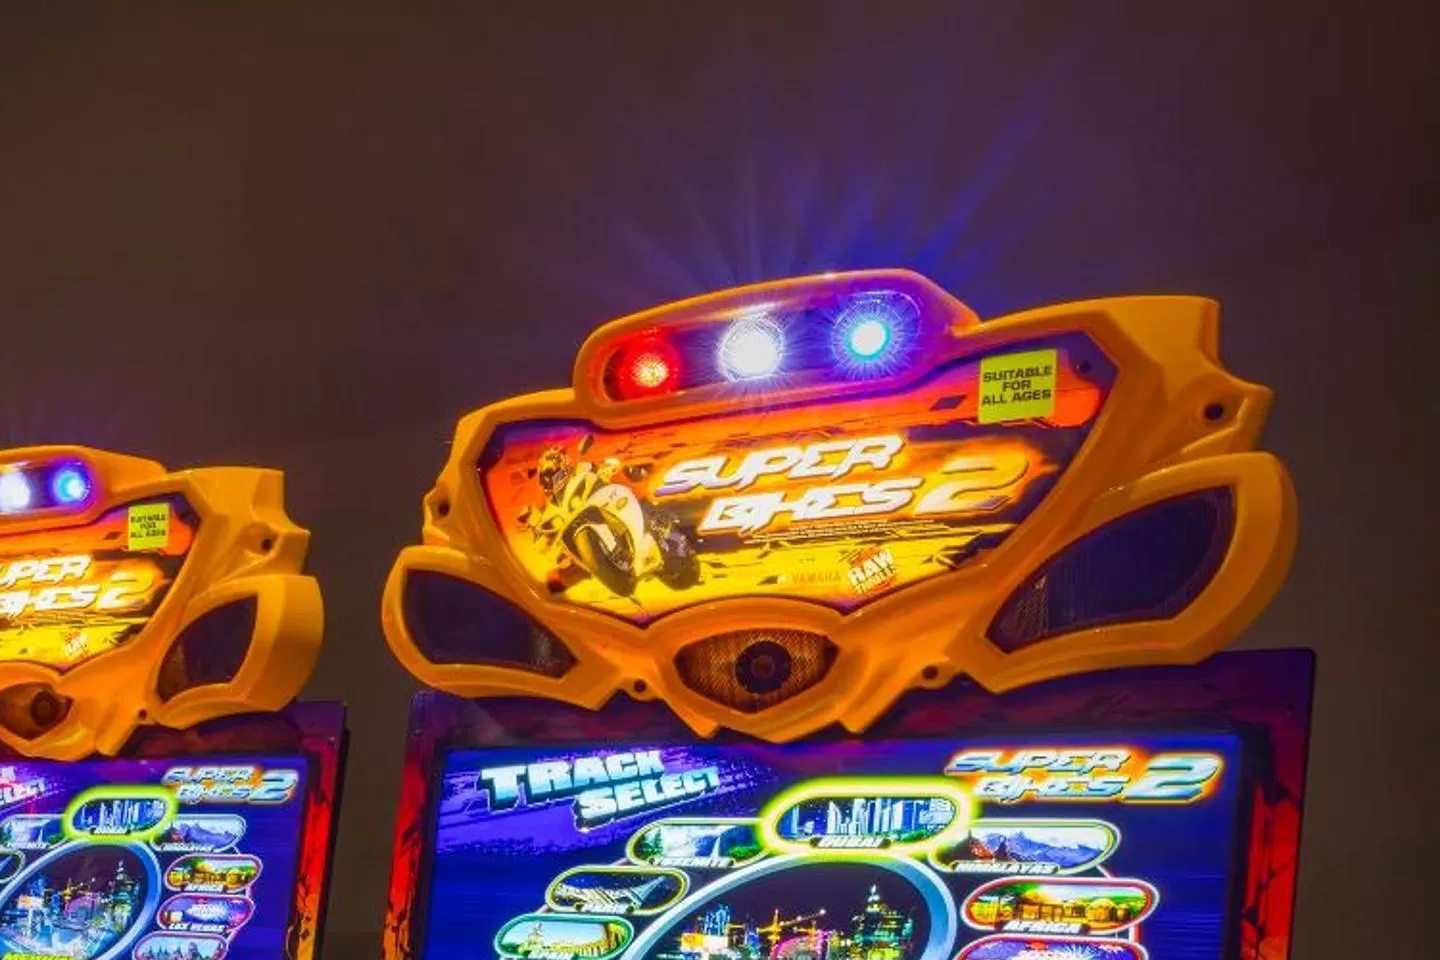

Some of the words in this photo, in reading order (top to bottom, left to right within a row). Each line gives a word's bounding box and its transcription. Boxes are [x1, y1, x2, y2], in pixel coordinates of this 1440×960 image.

[982, 365, 1053, 382] SUITABLE
[1001, 380, 1032, 392] FOR
[981, 393, 1008, 405] ALL
[1011, 389, 1052, 403] AGES
[656, 434, 906, 497] SUPER
[697, 475, 924, 533] BIKES
[913, 452, 1030, 518] 2
[848, 550, 894, 584] RAW
[95, 567, 156, 611] 2
[480, 750, 665, 803] TRACK
[946, 749, 1130, 774] SUPER
[973, 774, 1128, 802] BIKES
[1123, 753, 1222, 802] 2
[247, 768, 300, 804] 2
[574, 766, 719, 825] SELECT
